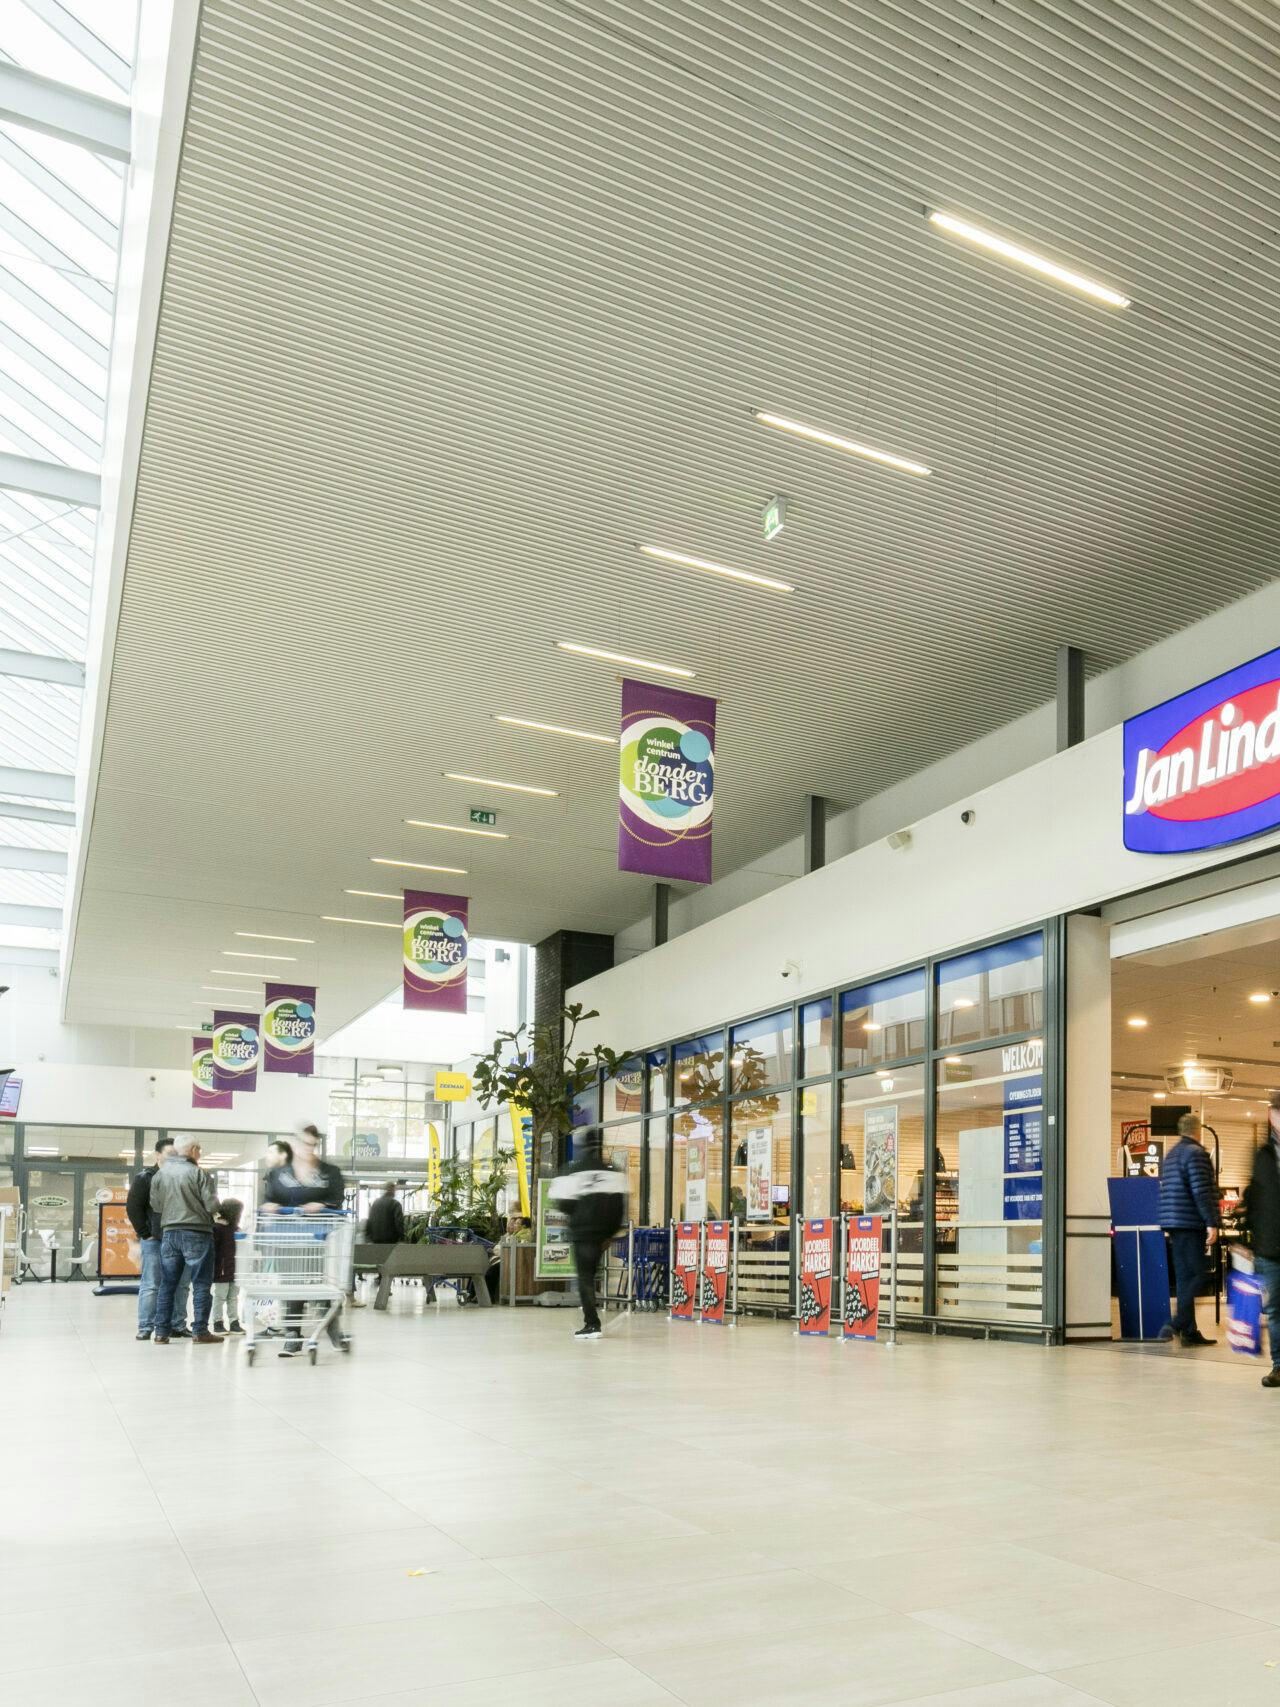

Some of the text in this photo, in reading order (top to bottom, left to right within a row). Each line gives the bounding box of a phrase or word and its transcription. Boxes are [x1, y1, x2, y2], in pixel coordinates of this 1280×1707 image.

[646, 737, 675, 751] winkel
[646, 746, 681, 760] centrum
[633, 756, 707, 784] donder
[632, 770, 708, 804] BERG
[412, 935, 462, 951] donder
[412, 946, 463, 963] BERG
[271, 1017, 311, 1028] donder
[271, 1024, 311, 1037] BERG
[1001, 1045, 1043, 1073] WELKOM
[805, 1239, 830, 1253] VOORDEEL
[850, 1237, 879, 1252] VOORDEEL
[805, 1252, 831, 1272] HARKEN
[849, 1252, 879, 1272] HARKEN
